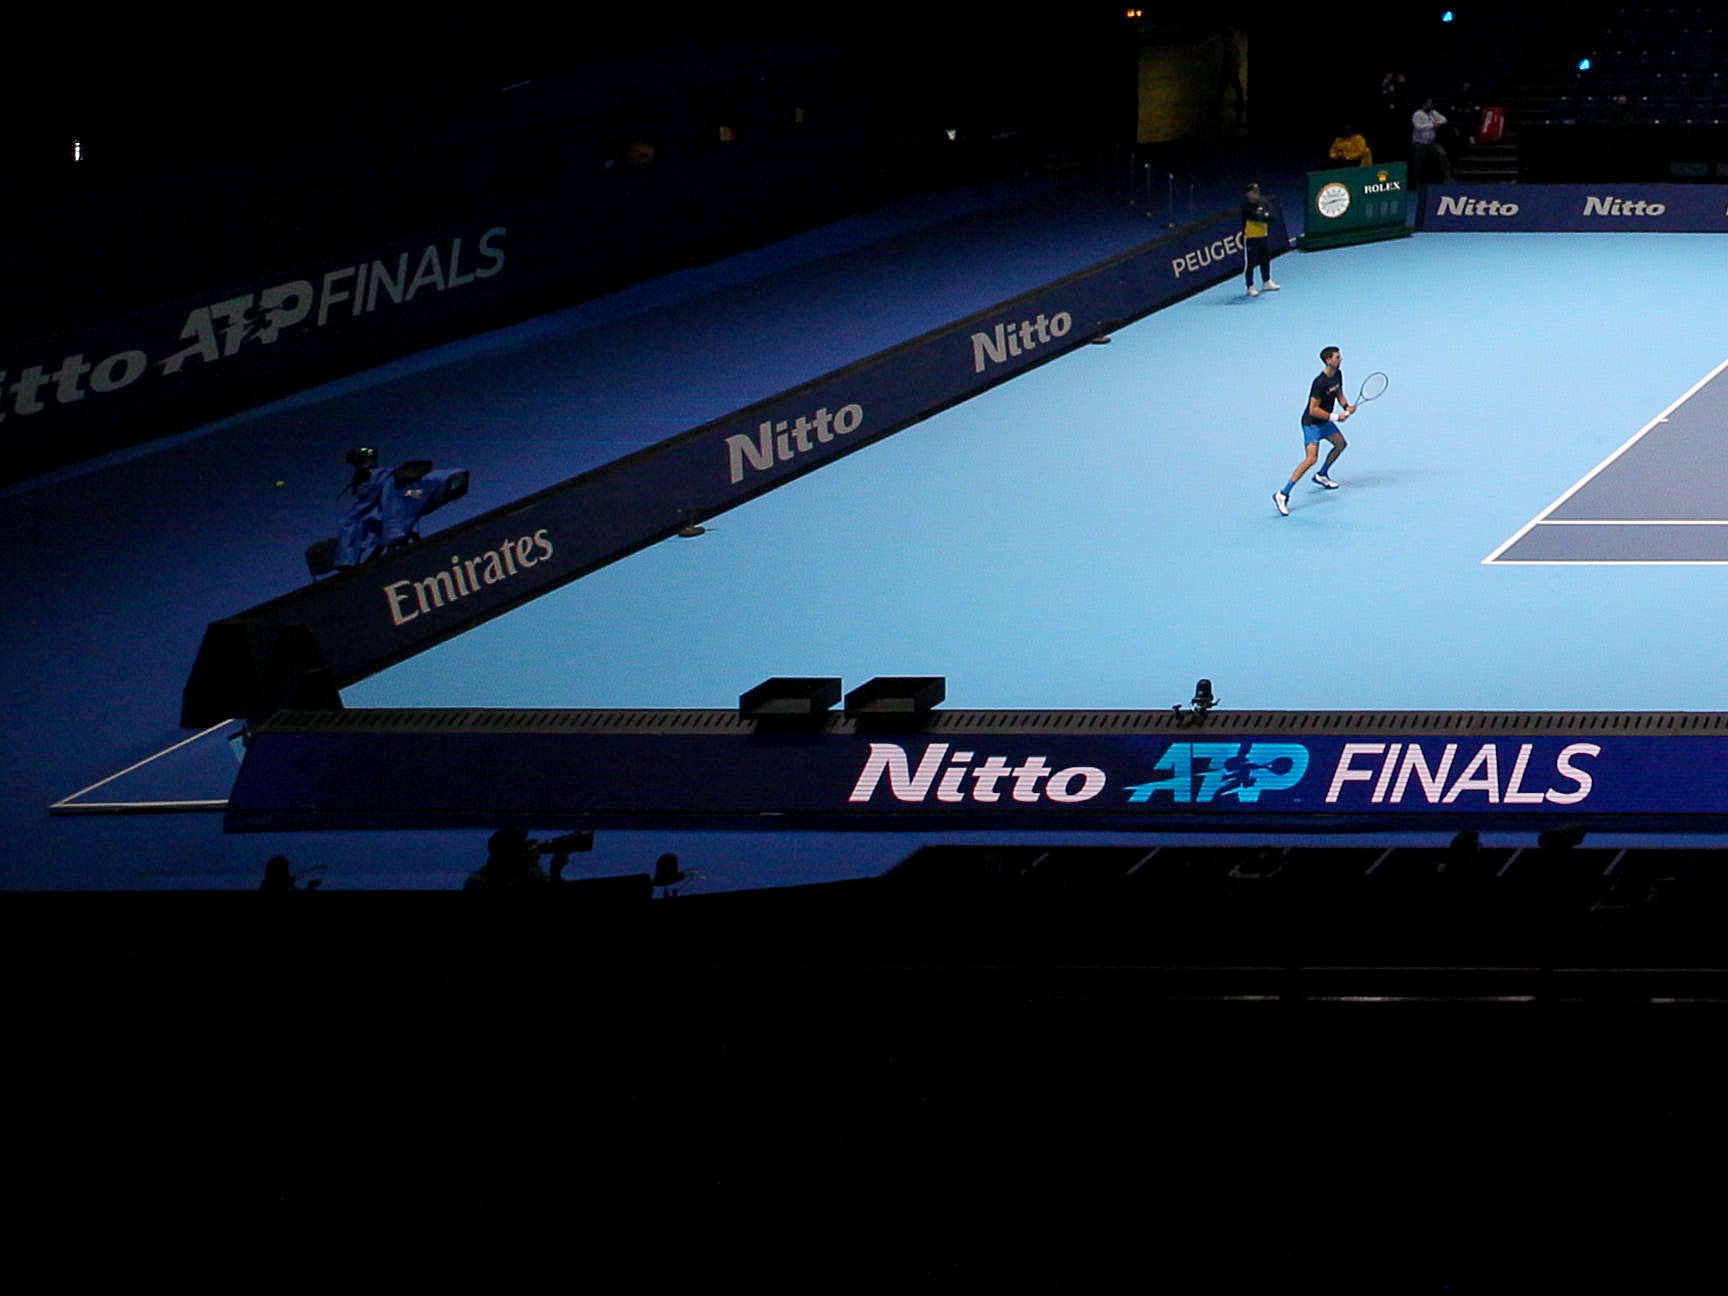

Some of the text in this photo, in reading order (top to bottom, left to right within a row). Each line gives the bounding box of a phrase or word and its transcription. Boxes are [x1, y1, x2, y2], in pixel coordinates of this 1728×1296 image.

[1364, 181, 1401, 194] ROLEX
[1436, 196, 1520, 216] Nitto
[1582, 196, 1666, 216] Nitto
[1172, 232, 1247, 278] PEUGE
[0, 227, 507, 422] tto ATP FINALS
[971, 311, 1072, 373] Nitto
[724, 403, 863, 484] Nitto
[383, 528, 553, 627] Emirates
[848, 741, 1601, 804] Nitto ATP FINALS
